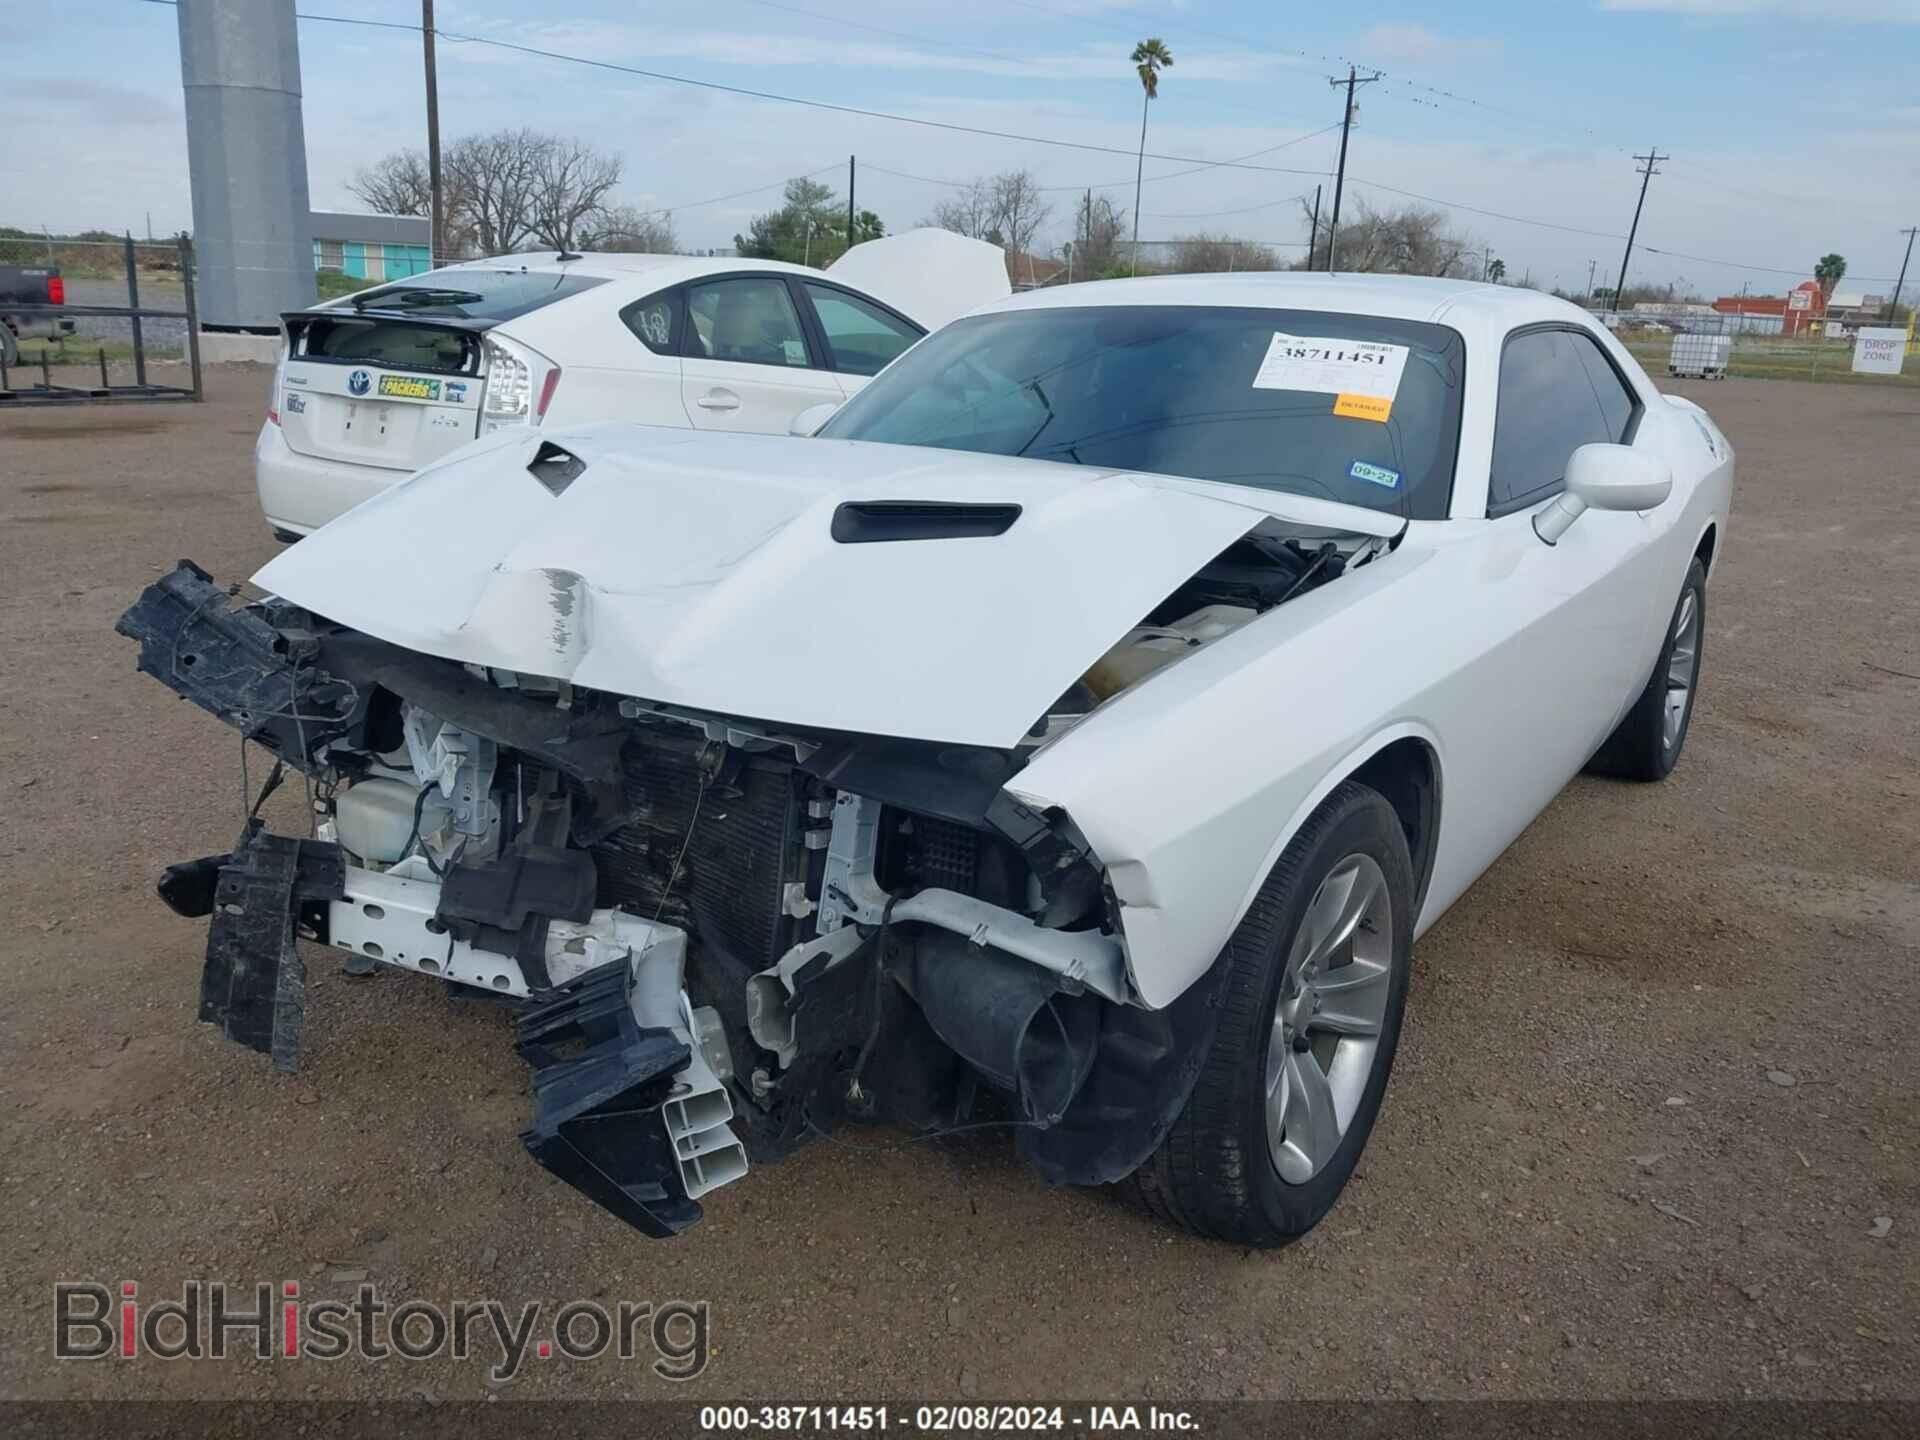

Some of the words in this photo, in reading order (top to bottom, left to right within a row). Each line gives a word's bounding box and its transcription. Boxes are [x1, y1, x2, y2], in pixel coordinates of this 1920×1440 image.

[1865, 340, 1897, 351] DROP
[1279, 347, 1385, 365] 38711451
[1863, 352, 1894, 361] ZONE
[384, 381, 429, 397] PACKERS
